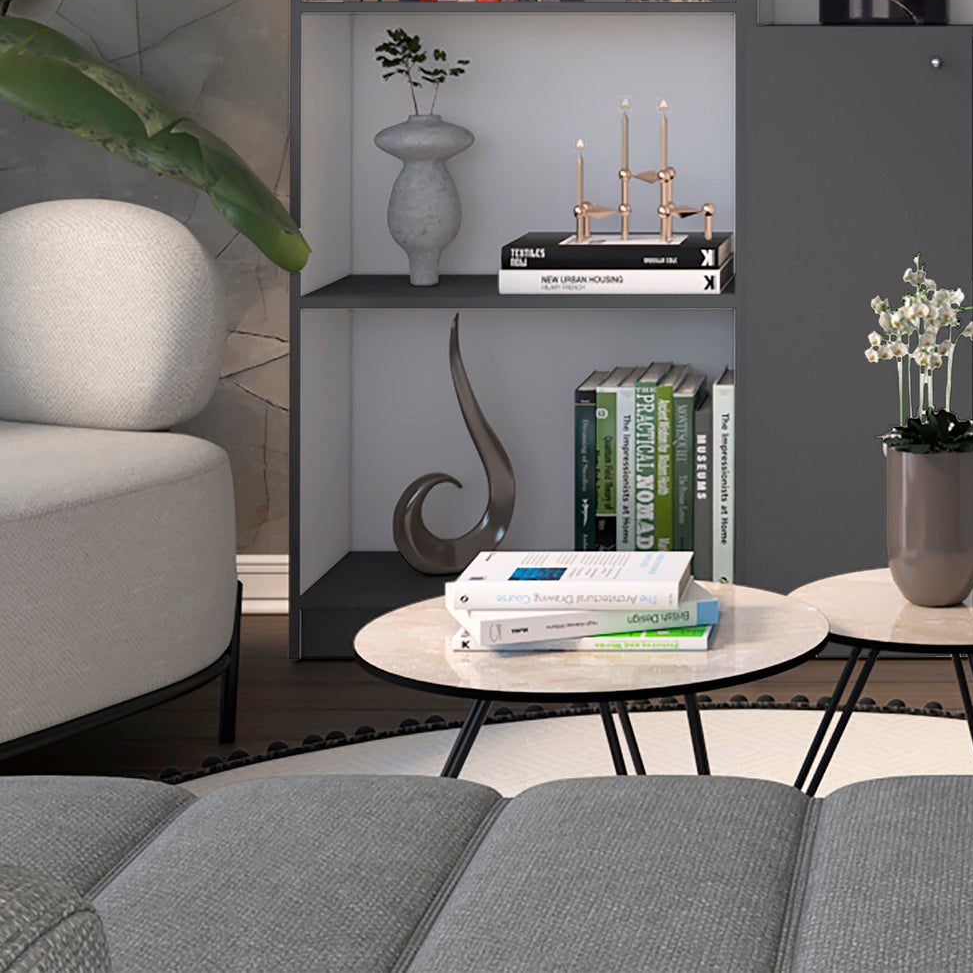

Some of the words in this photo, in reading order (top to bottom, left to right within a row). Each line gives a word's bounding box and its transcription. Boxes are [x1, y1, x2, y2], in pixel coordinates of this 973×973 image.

[541, 276, 558, 284] NEW
[560, 276, 587, 284] URBAN
[589, 276, 624, 284] HOUSING
[621, 414, 631, 431] The
[719, 414, 729, 430] The
[637, 394, 654, 472] PRACTICAL
[603, 436, 613, 463] Quantum
[603, 466, 613, 480] Field
[621, 434, 631, 503] Impressionists
[697, 434, 706, 499] MUSEUMS
[719, 433, 729, 503] Impressionists
[603, 483, 613, 501] Theory
[603, 502, 613, 510] of
[621, 505, 631, 515] at
[637, 474, 654, 549] NOMAD
[719, 505, 729, 515] at
[621, 517, 631, 544] Home
[719, 517, 729, 545] Home
[496, 595, 531, 604] Course
[533, 593, 574, 604] Drawing
[577, 595, 637, 604] Architectural
[640, 595, 657, 604] The
[627, 613, 658, 625] Design
[661, 610, 690, 623] British
